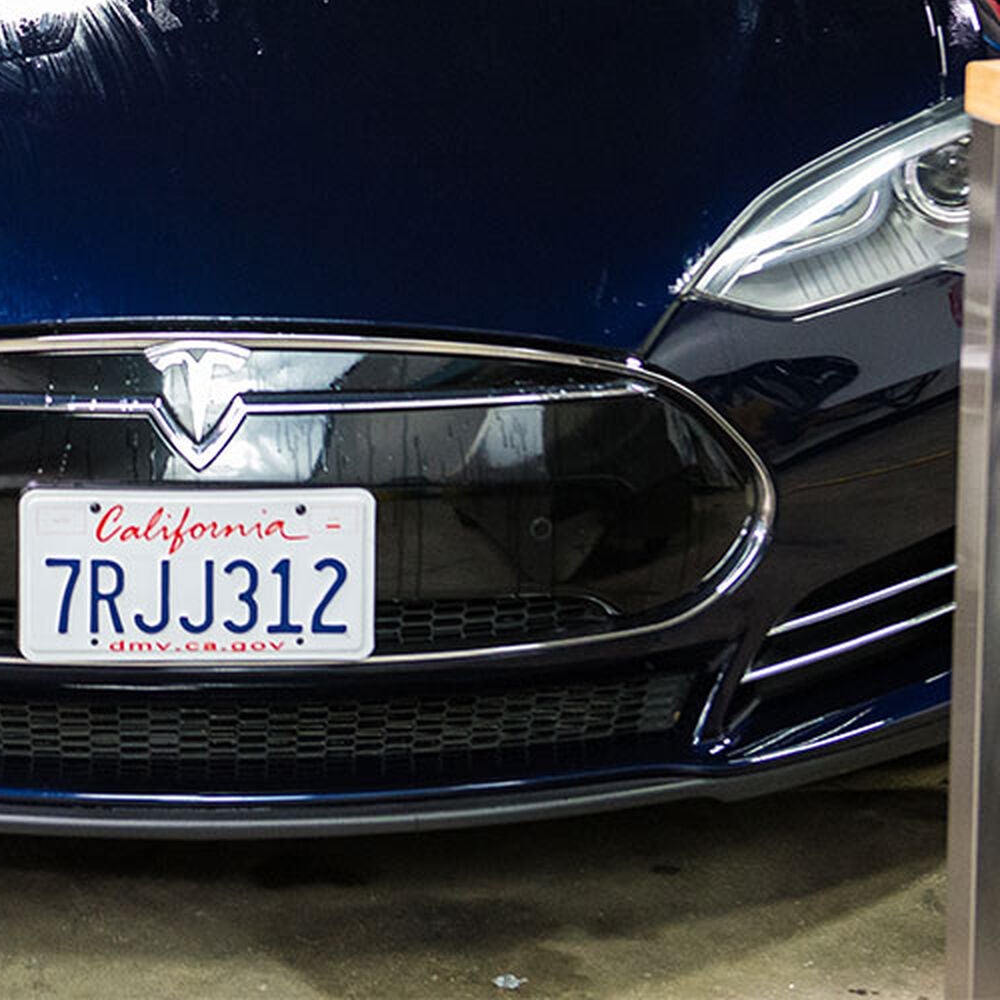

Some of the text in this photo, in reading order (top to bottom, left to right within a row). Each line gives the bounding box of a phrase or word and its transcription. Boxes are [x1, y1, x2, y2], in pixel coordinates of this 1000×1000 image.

[95, 504, 309, 554] California
[45, 558, 348, 635] 7RJJ312
[109, 639, 285, 652] dmv.ca.gov
